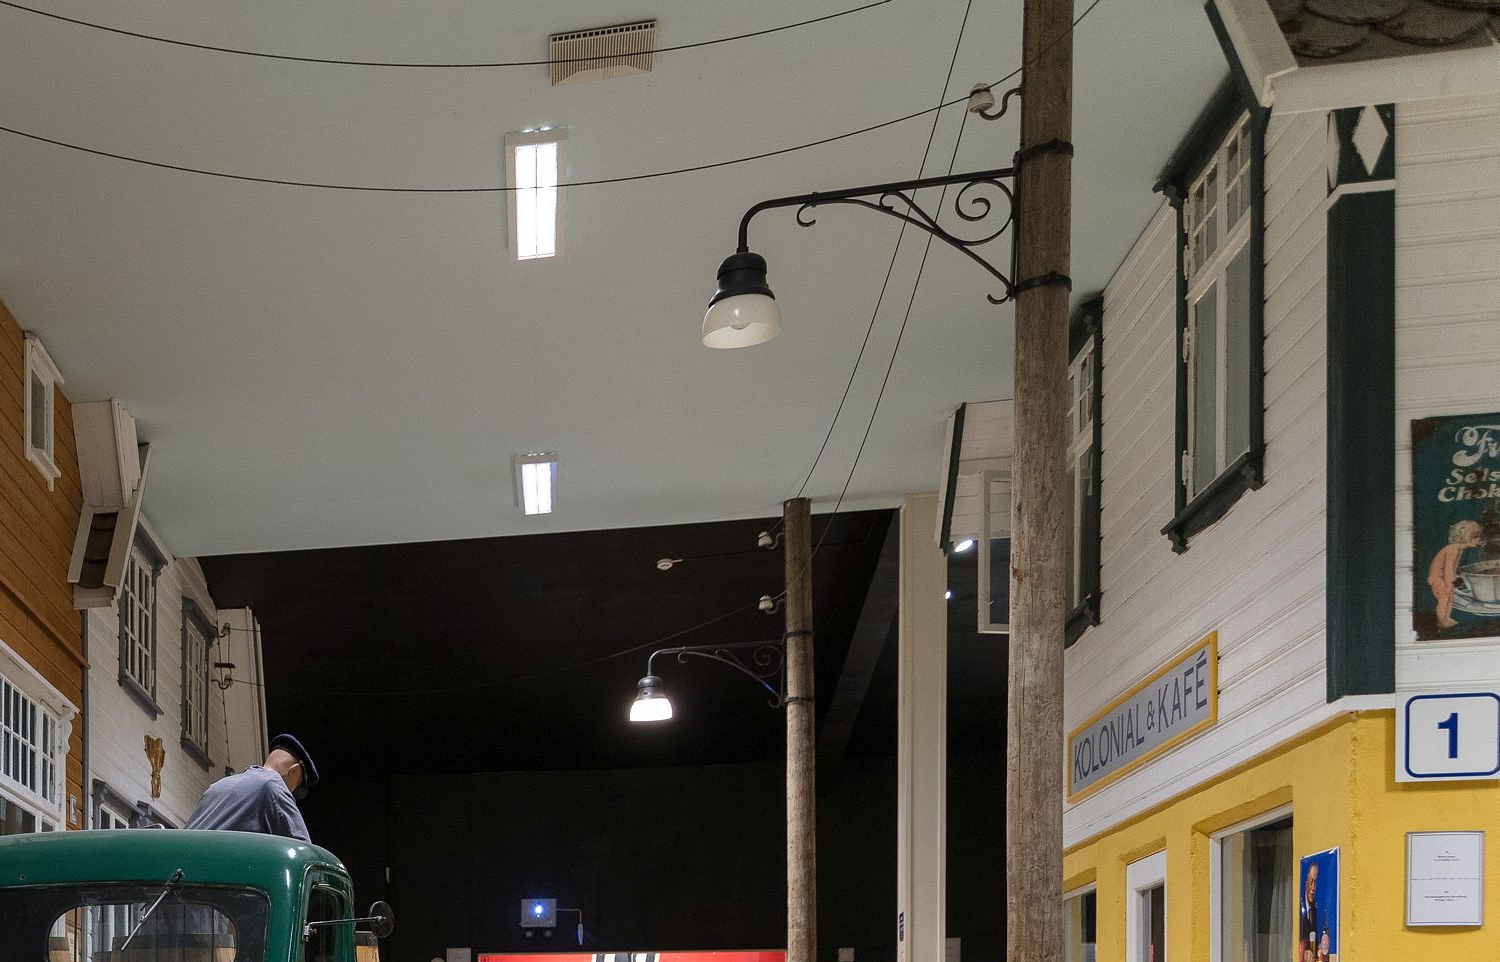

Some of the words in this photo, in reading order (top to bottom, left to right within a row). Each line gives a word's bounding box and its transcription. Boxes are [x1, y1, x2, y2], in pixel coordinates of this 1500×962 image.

[1074, 703, 1145, 783] KOLONIAL
[1146, 700, 1155, 730] &
[1158, 650, 1207, 732] KAFÉ
[1437, 712, 1458, 759] 1
